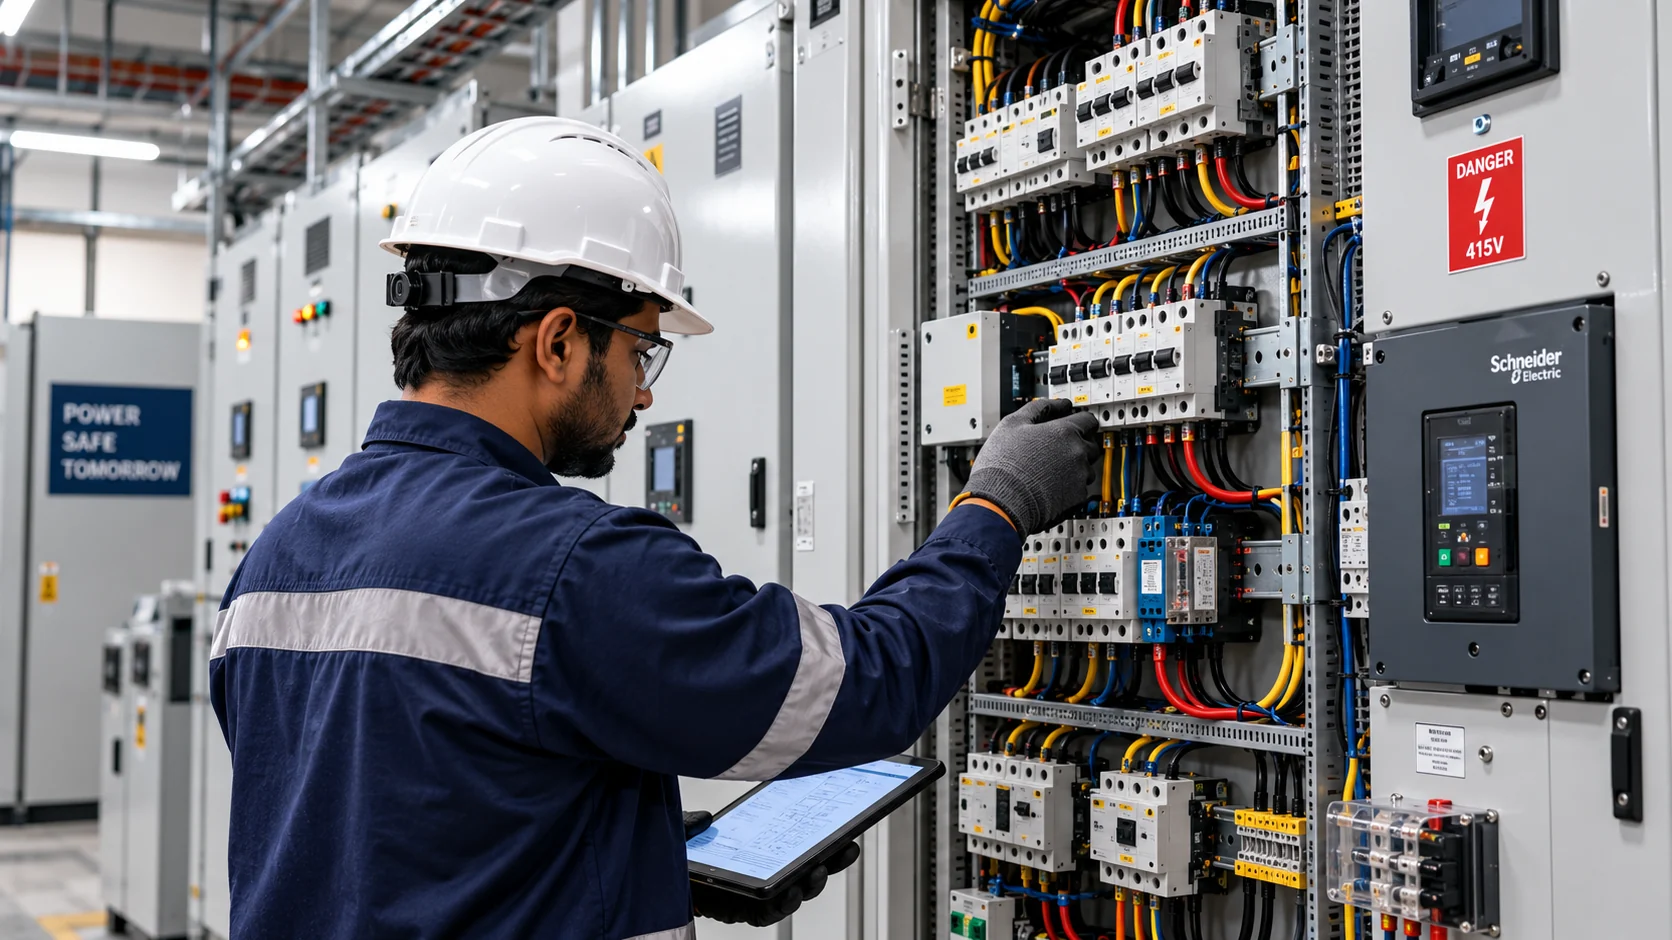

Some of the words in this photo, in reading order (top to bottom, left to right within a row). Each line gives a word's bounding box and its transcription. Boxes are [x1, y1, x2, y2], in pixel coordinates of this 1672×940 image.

[1456, 149, 1514, 180] DANGER
[1465, 235, 1504, 260] 415V
[1490, 348, 1563, 373] Schneider
[1522, 367, 1562, 382] Electric
[62, 402, 141, 426] POWER
[62, 431, 117, 454] SAFE
[61, 459, 181, 482] TOMORROW
